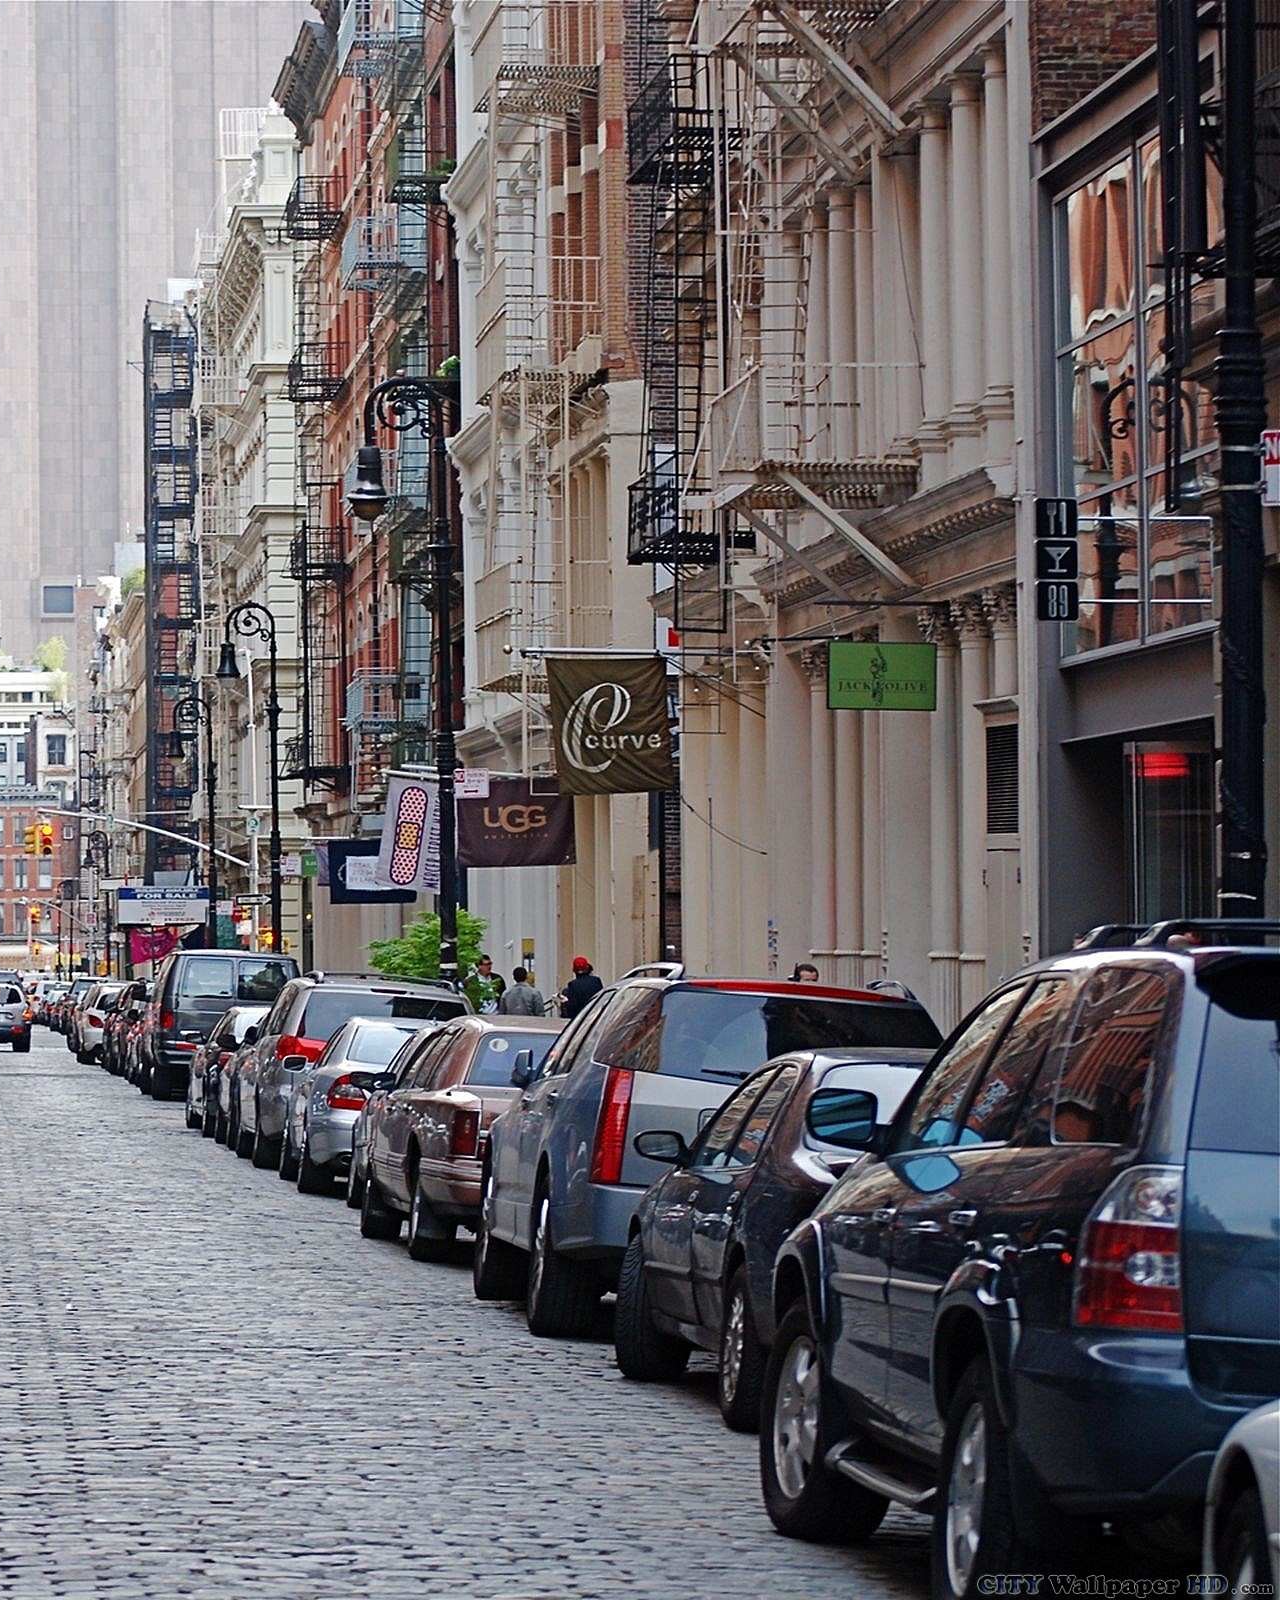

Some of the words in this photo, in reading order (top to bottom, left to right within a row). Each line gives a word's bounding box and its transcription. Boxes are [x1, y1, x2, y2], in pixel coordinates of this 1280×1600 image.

[1265, 437, 1280, 460] N
[1048, 585, 1068, 617] 89
[837, 680, 871, 692] JACK
[884, 680, 928, 692] OLIVE
[585, 733, 661, 750] curve
[483, 804, 547, 833] UGG
